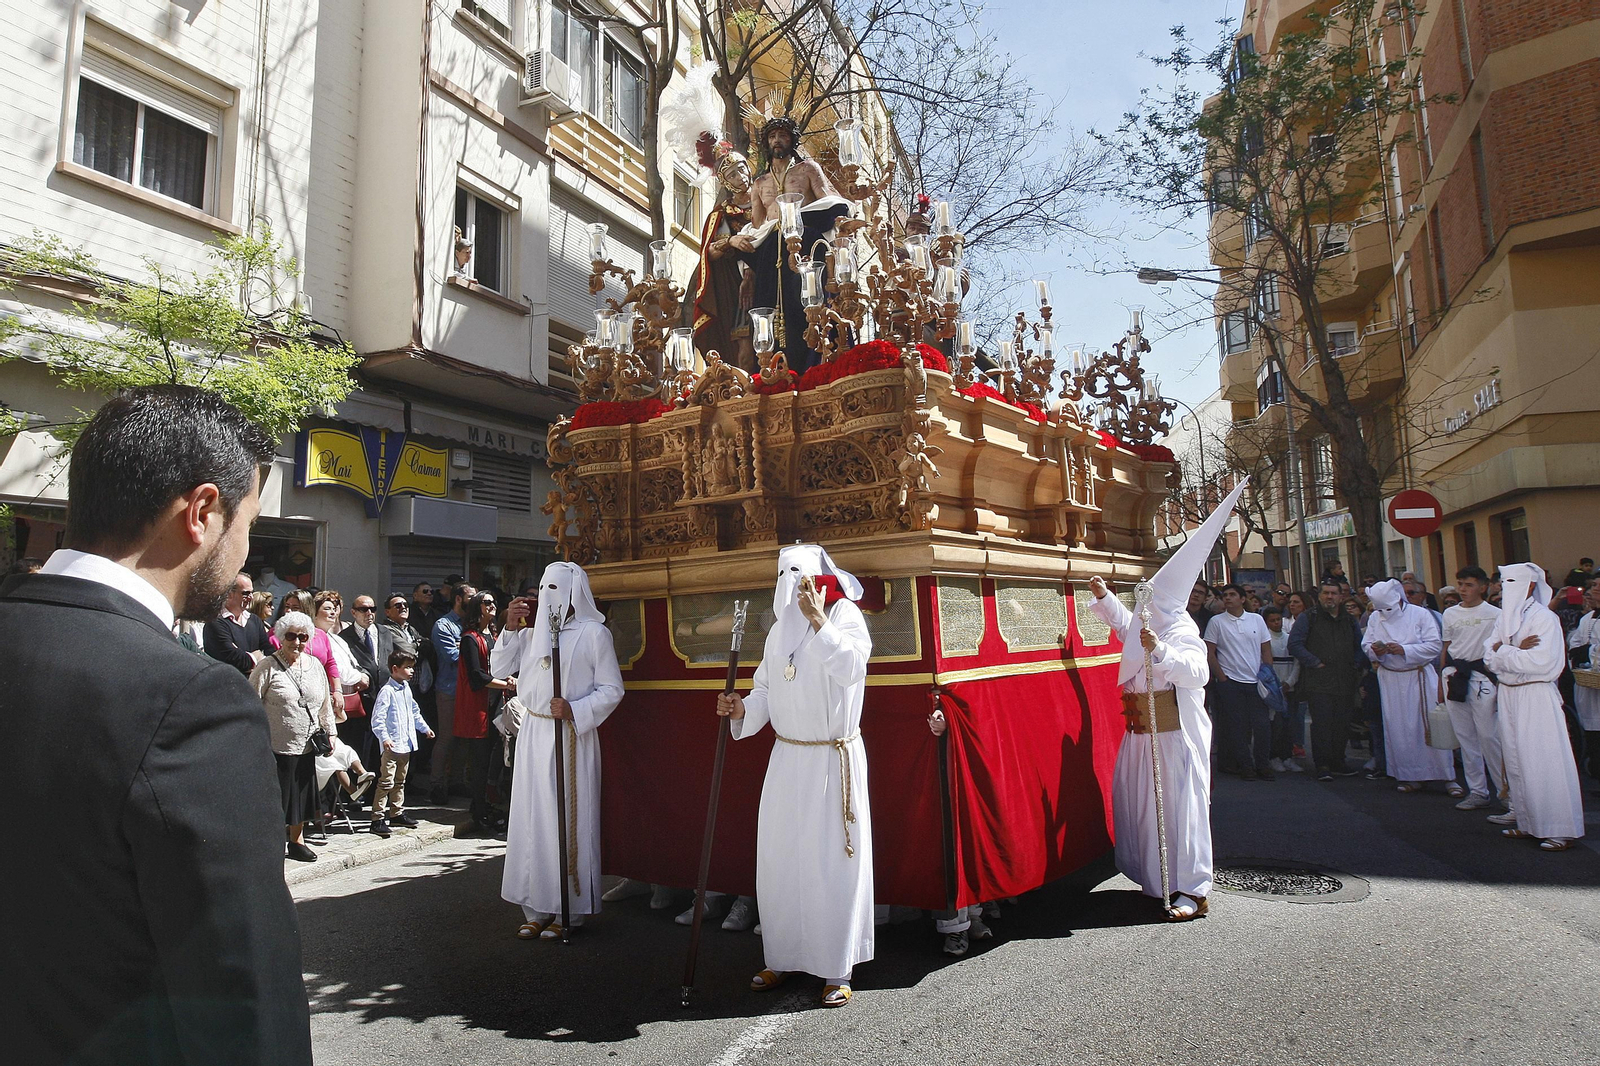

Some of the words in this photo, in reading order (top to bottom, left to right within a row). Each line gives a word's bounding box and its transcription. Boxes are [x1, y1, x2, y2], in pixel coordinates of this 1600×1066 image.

[468, 425, 515, 450] MARI
[315, 449, 352, 478] Mari
[405, 448, 441, 478] Carmen
[377, 428, 388, 496] TIENDA
